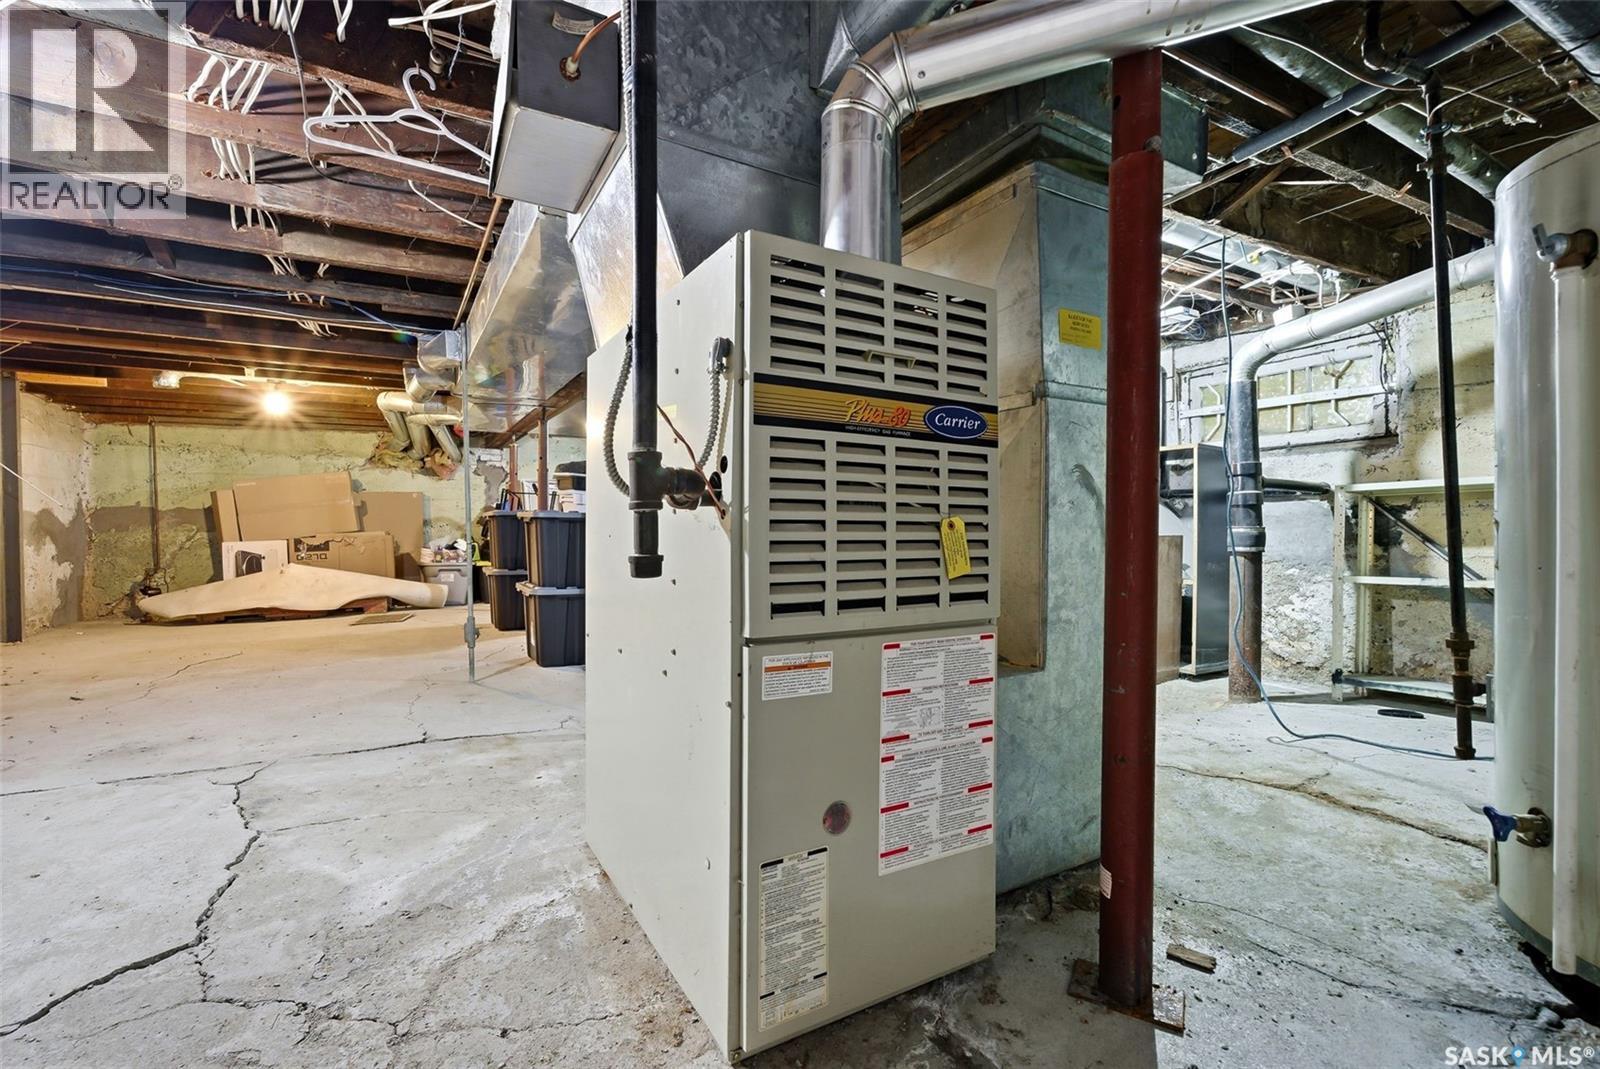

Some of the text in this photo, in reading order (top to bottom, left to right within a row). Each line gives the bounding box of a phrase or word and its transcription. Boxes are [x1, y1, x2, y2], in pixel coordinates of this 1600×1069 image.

[845, 399, 911, 428] Plus 80
[935, 412, 981, 430] Carrier
